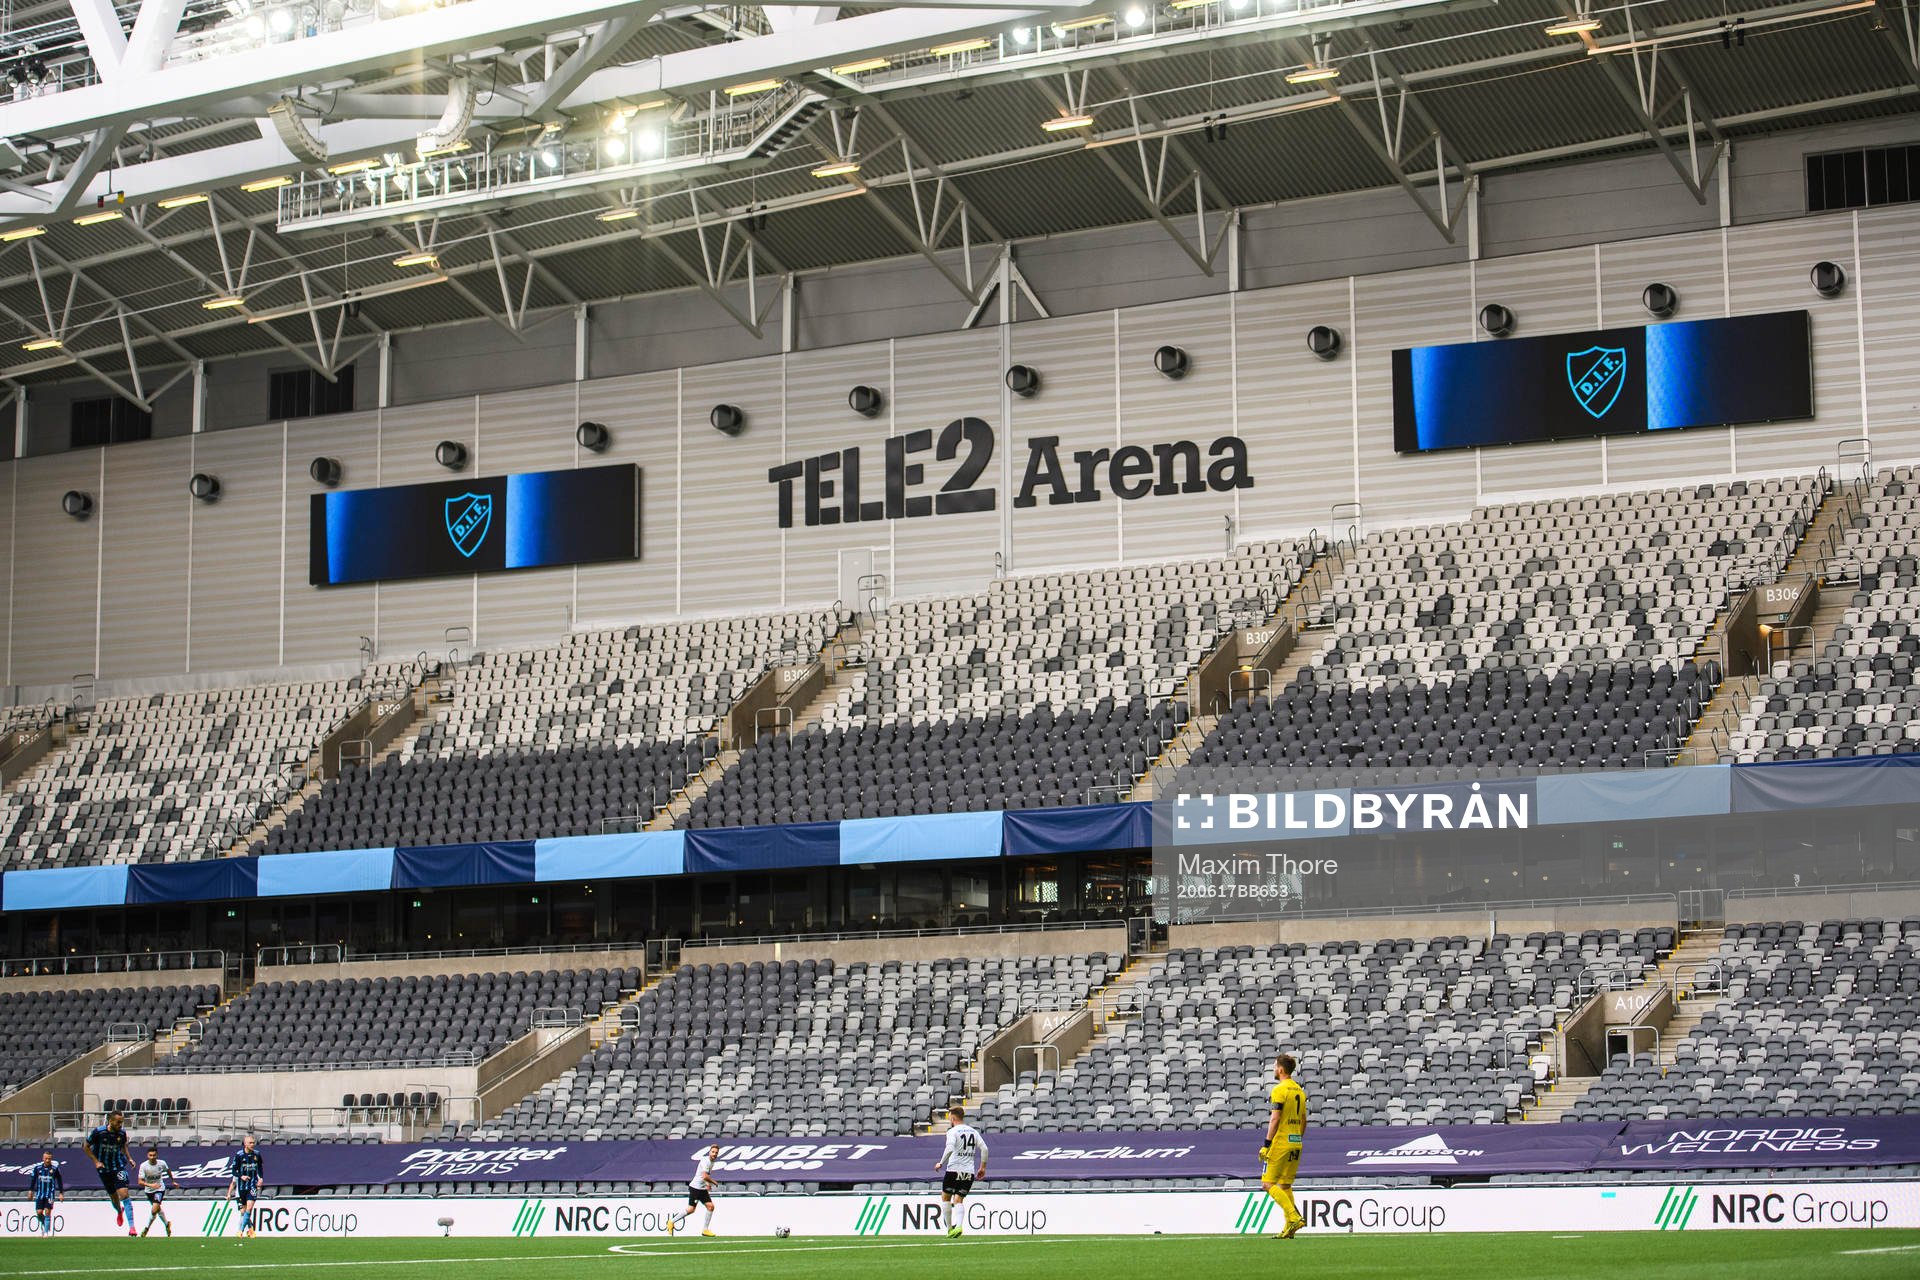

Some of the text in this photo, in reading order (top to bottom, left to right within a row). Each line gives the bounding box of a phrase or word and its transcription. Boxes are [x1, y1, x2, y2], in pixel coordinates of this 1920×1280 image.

[1579, 357, 1620, 396] D.I.F.
[768, 416, 1255, 528] TELE2 Arena
[454, 503, 487, 537] D.I.F.
[1766, 587, 1799, 602] B306
[960, 1133, 976, 1150] 14
[1621, 1139, 1881, 1155] WELLNESS
[1667, 1127, 1846, 1143] NORDIC
[400, 1146, 568, 1164] Prioritet
[690, 1144, 888, 1161] UNIBET
[1012, 1145, 1196, 1160] stadium
[397, 1161, 519, 1177] Finans
[6, 1208, 65, 1237] Grop
[294, 1206, 358, 1237] Group
[555, 1205, 686, 1236] NRC Group
[902, 1202, 1047, 1236] NR Group
[1359, 1198, 1446, 1233] Group
[1712, 1192, 1889, 1229] NRC Group
